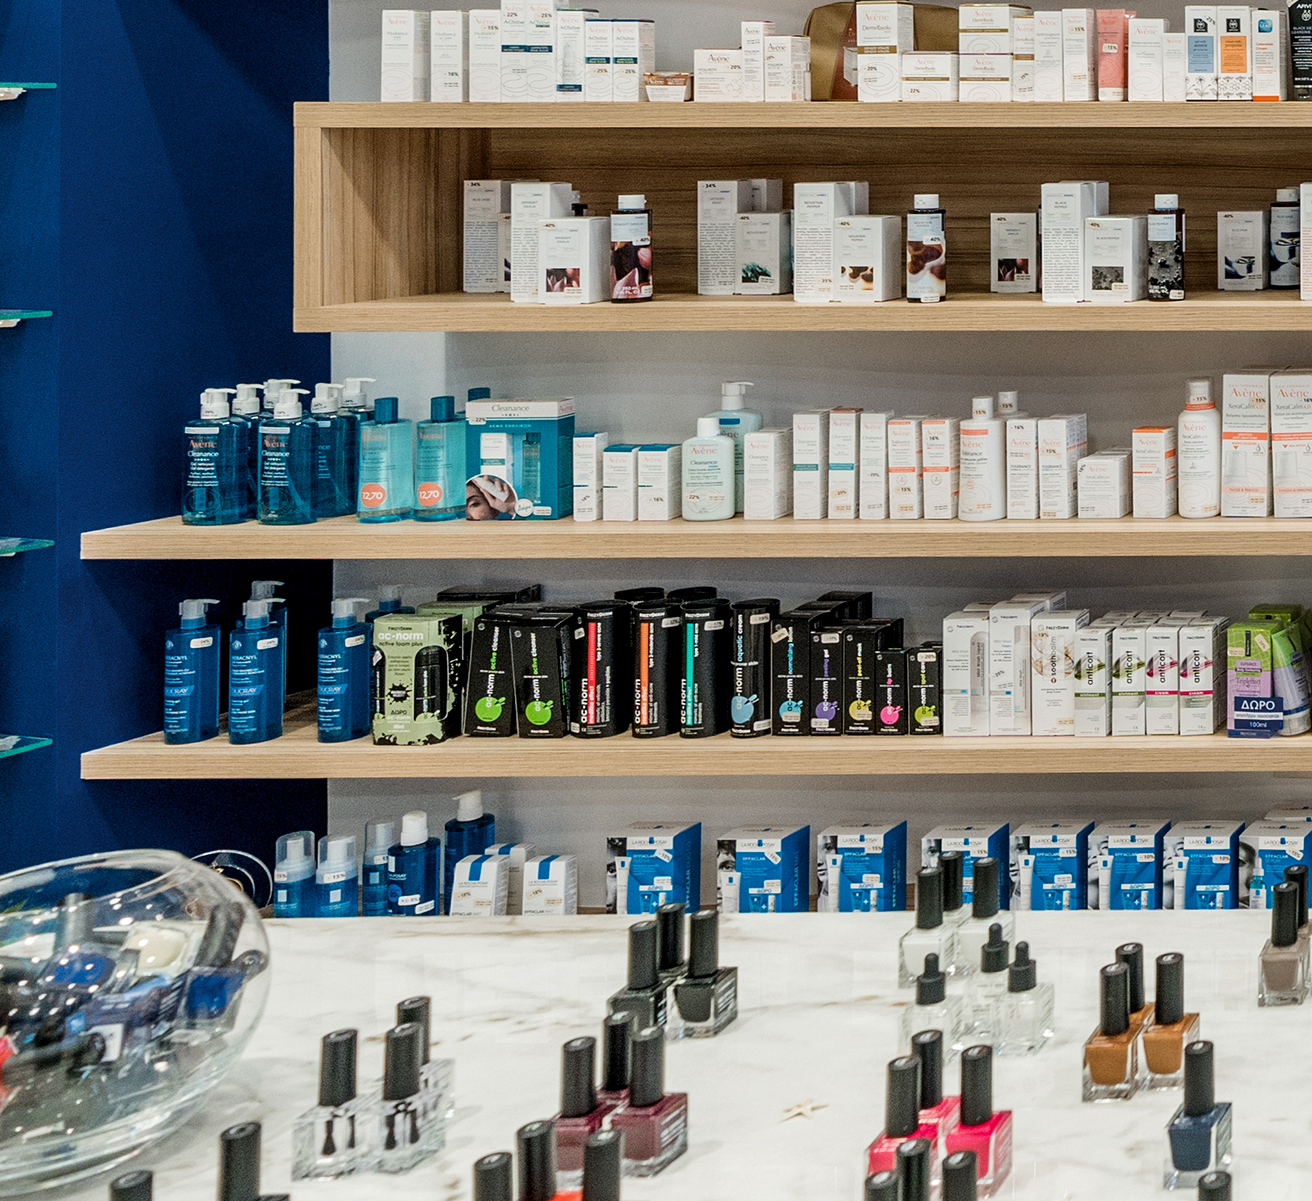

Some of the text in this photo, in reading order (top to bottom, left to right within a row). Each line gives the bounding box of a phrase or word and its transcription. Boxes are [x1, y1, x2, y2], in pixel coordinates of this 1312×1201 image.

[492, 404, 530, 412] Cleanance
[362, 491, 383, 500] 12,70
[417, 490, 440, 500] 12,70
[378, 631, 424, 642] ac-norm
[1086, 651, 1094, 686] anticort
[1241, 700, 1275, 711] ΔΩΡΟ
[1249, 721, 1267, 729] 100ml
